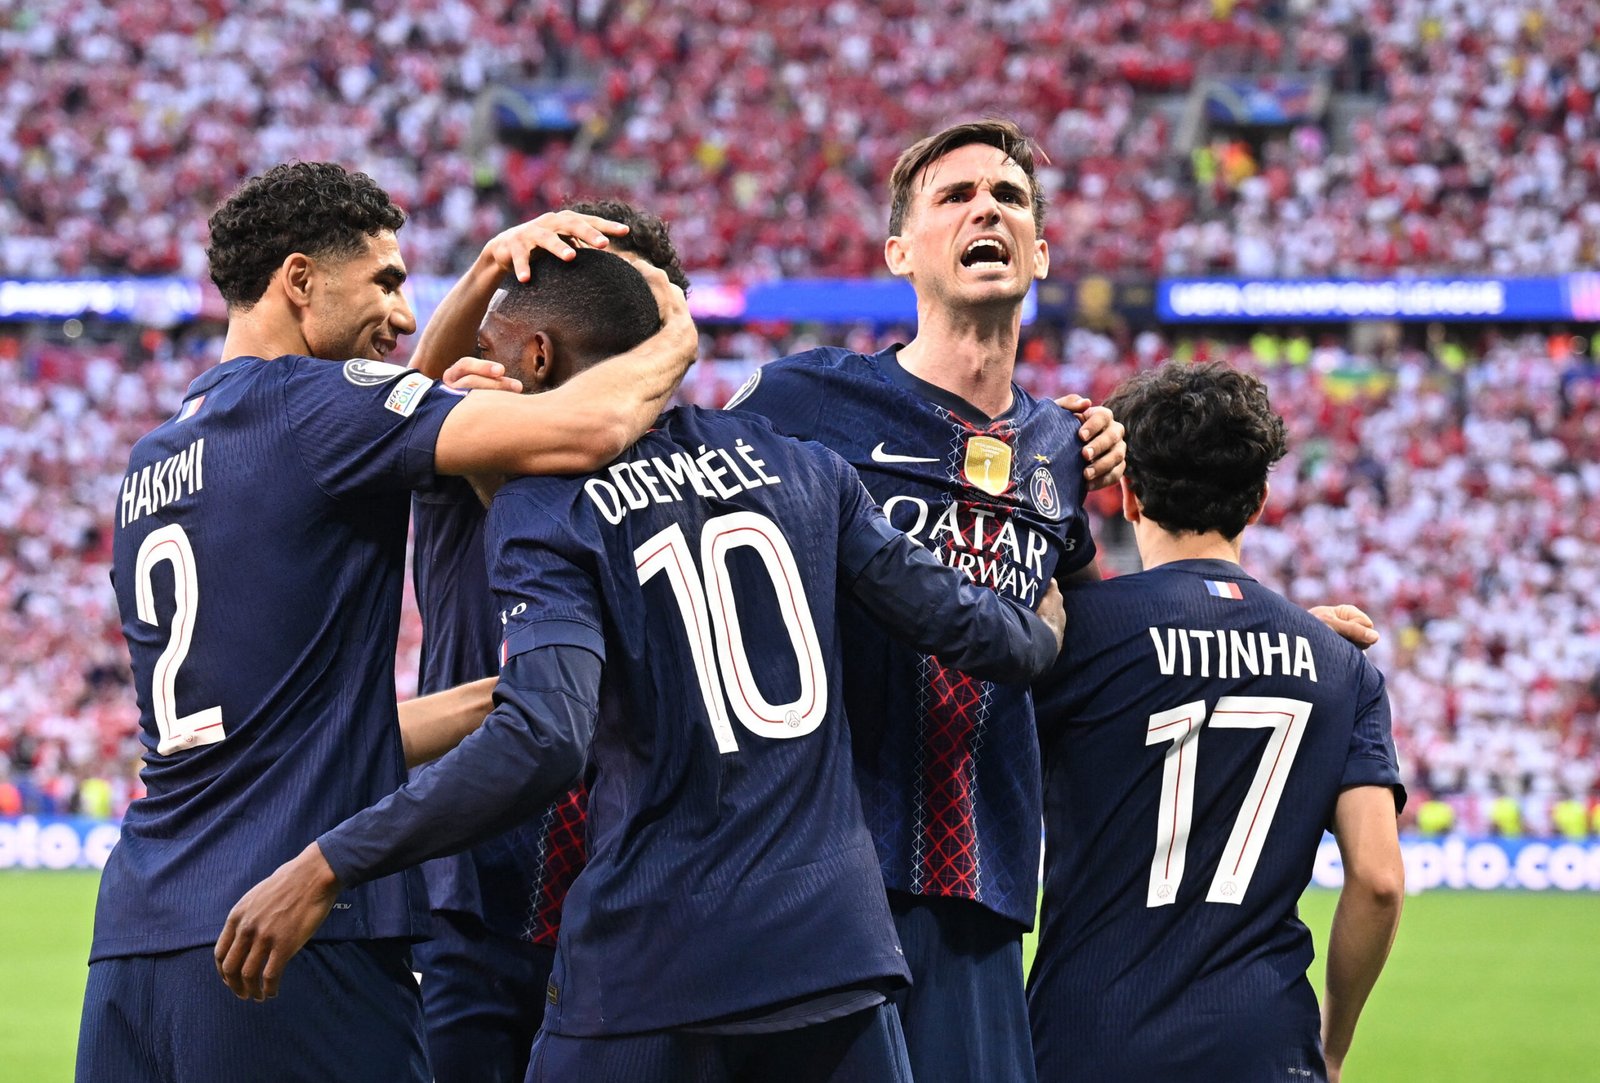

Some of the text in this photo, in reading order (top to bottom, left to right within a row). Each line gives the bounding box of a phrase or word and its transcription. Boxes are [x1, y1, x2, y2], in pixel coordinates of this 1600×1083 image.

[387, 390, 400, 408] UEFA
[121, 438, 204, 528] HAKIMI
[882, 495, 1048, 580] QATAR
[933, 546, 1039, 608] AIRWAYS
[135, 523, 226, 756] 2
[633, 511, 828, 754] 10
[1149, 627, 1318, 682] VITINHA
[1145, 696, 1313, 908] 17
